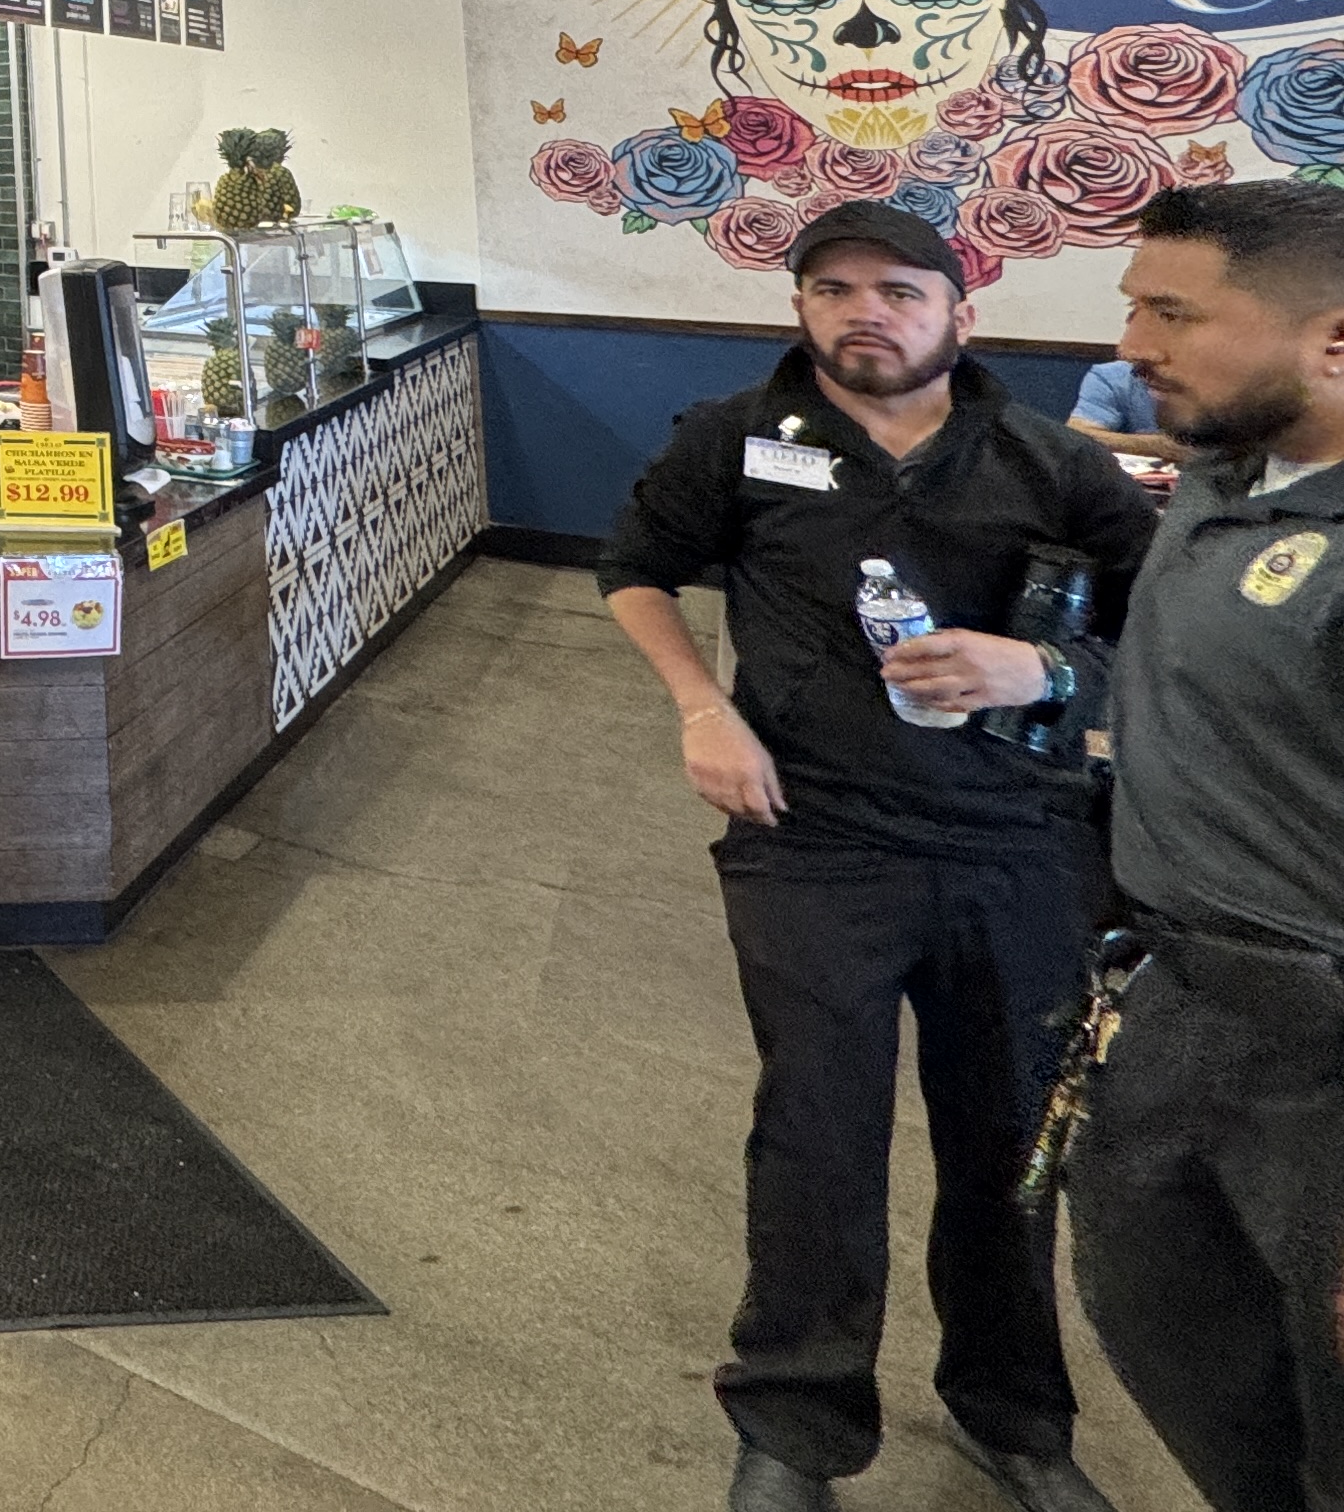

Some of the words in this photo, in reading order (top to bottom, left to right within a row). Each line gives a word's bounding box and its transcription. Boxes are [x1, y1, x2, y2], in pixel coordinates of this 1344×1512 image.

[78, 450, 94, 458] EN
[14, 459, 47, 467] SALSA
[49, 459, 85, 467] VERDE
[24, 468, 76, 476] PLATILLO
[6, 482, 89, 503] $12.99
[13, 610, 61, 627] $4.98
